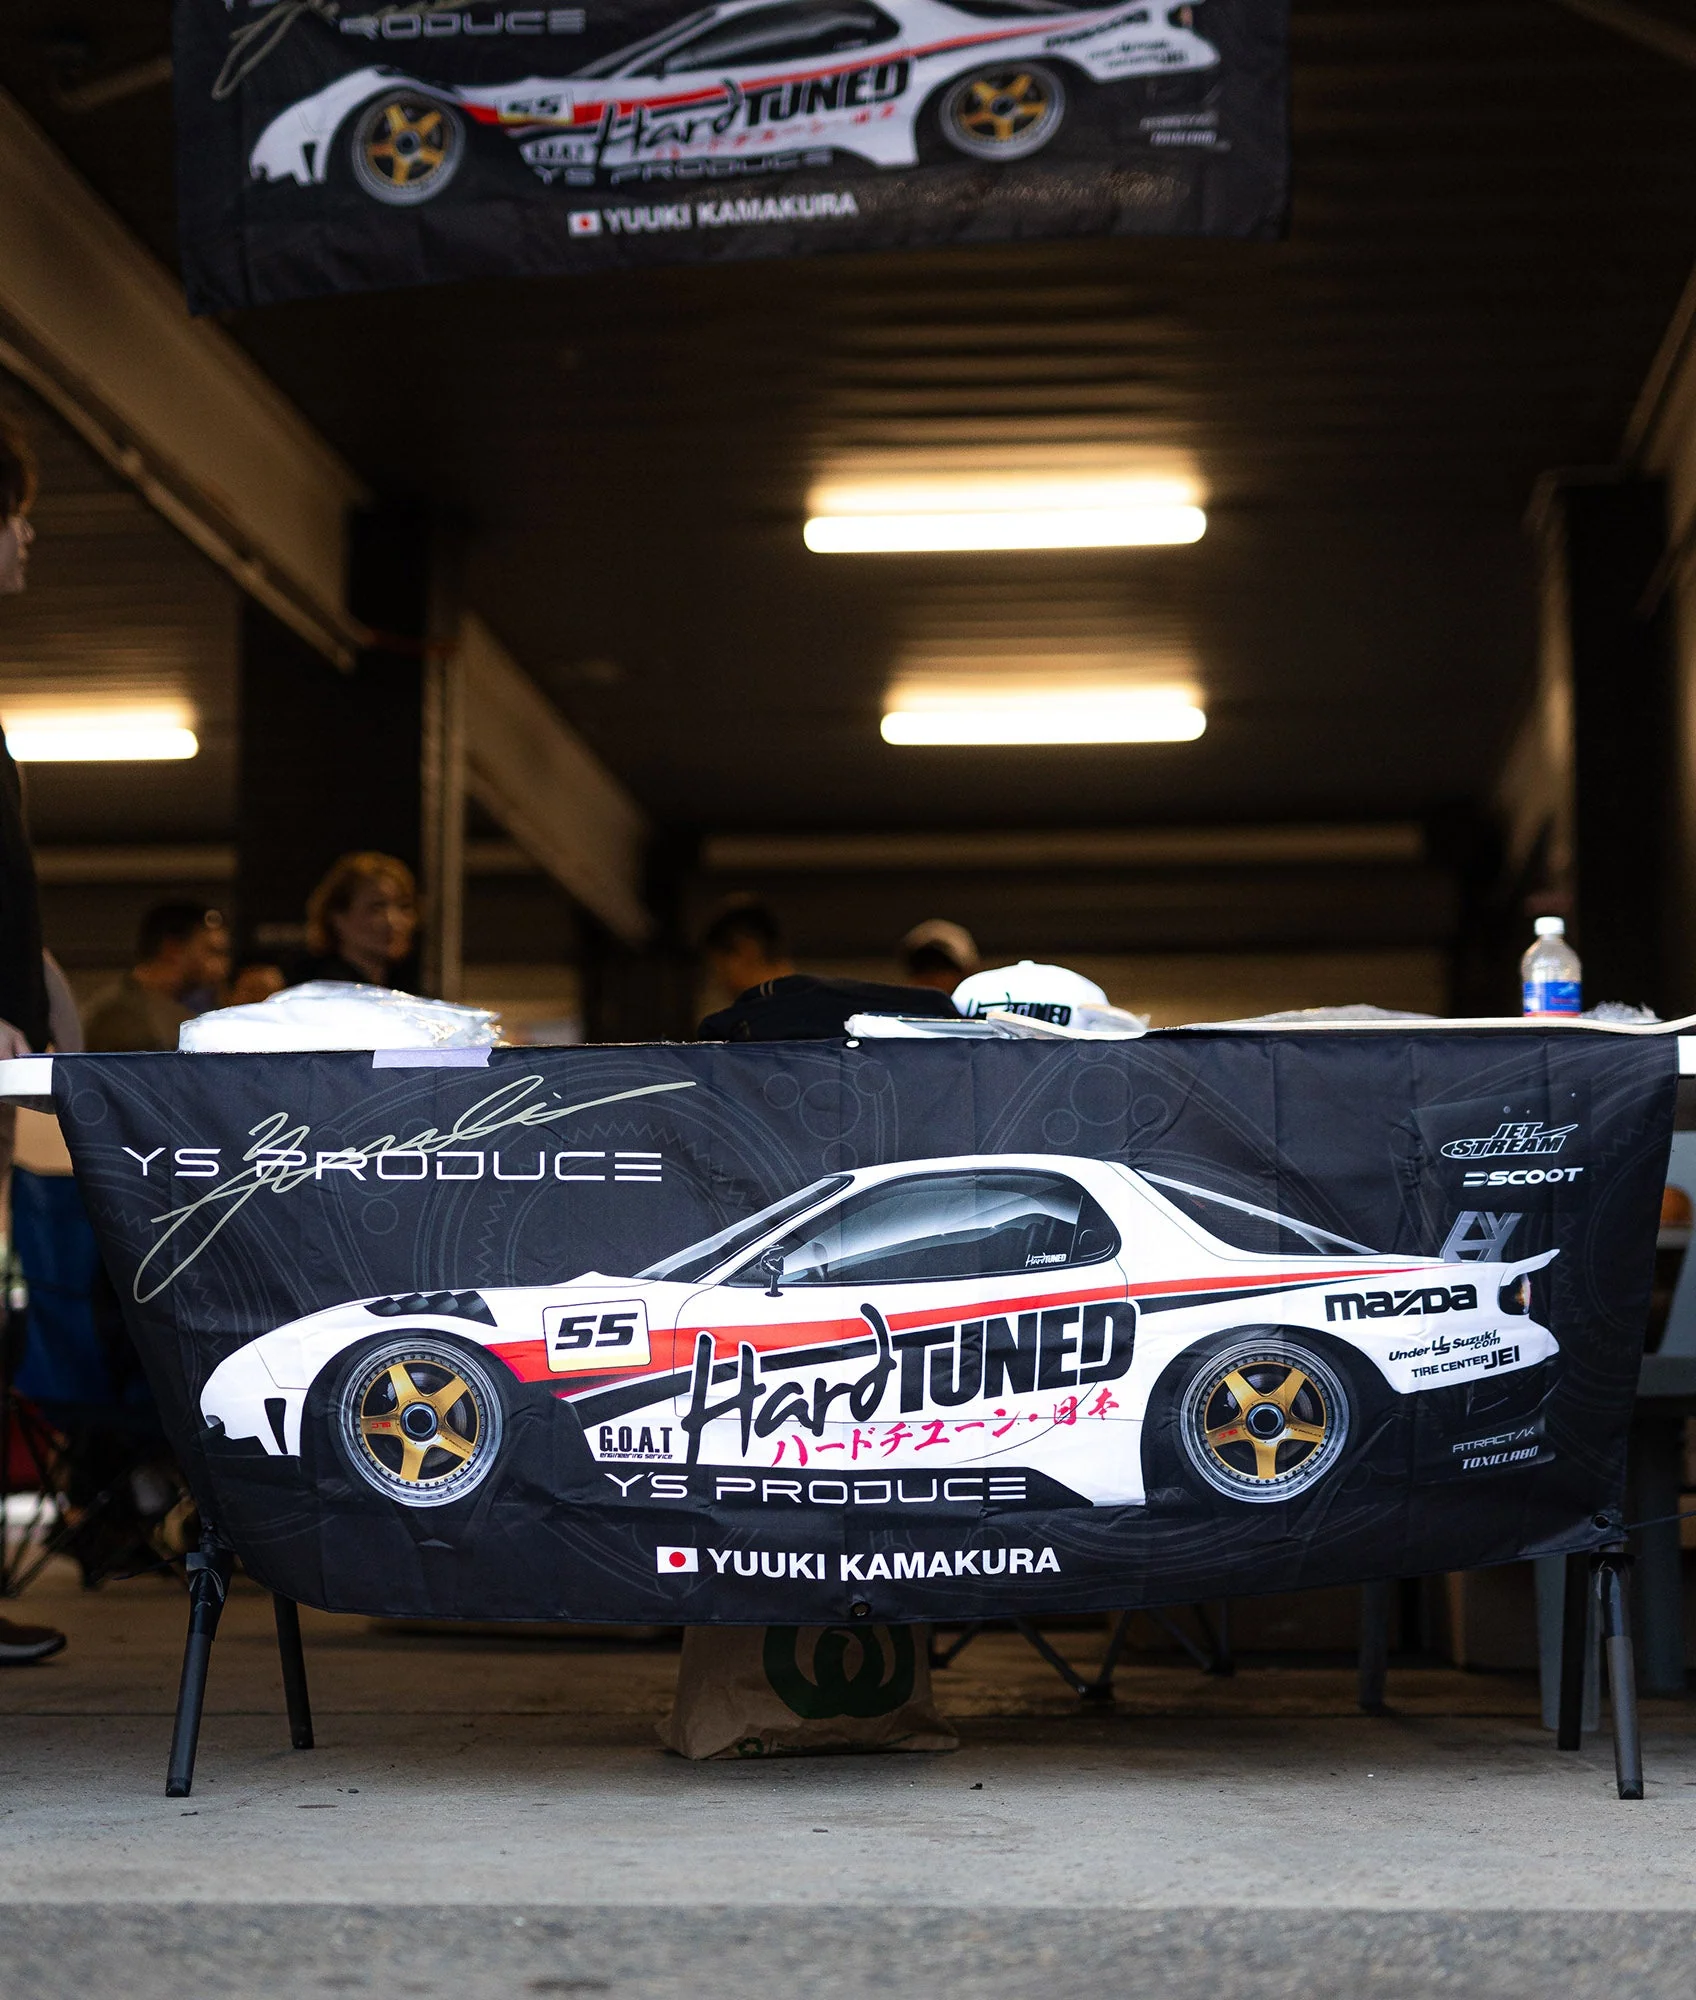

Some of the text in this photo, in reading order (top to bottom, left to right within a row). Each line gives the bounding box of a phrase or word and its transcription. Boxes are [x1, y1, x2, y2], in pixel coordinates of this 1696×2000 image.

[603, 191, 861, 234] YUUKI KAMAKURA
[1451, 1136, 1567, 1158] STREAM
[1492, 1122, 1544, 1139] JET
[121, 1146, 662, 1182] YS PRODUCE
[553, 1312, 639, 1351] 55
[1388, 1345, 1430, 1361] Under
[1411, 1345, 1520, 1378] TIRE CENTER JEI
[683, 1302, 1136, 1464] HardTUNED
[599, 1425, 673, 1454] G.O.A.T
[599, 1451, 674, 1461] engineering service
[1461, 1445, 1540, 1470] TOXICLABO
[604, 1471, 1026, 1504] Y'S PRODUCE
[706, 1546, 1061, 1582] YUUKI KAMAKURA
